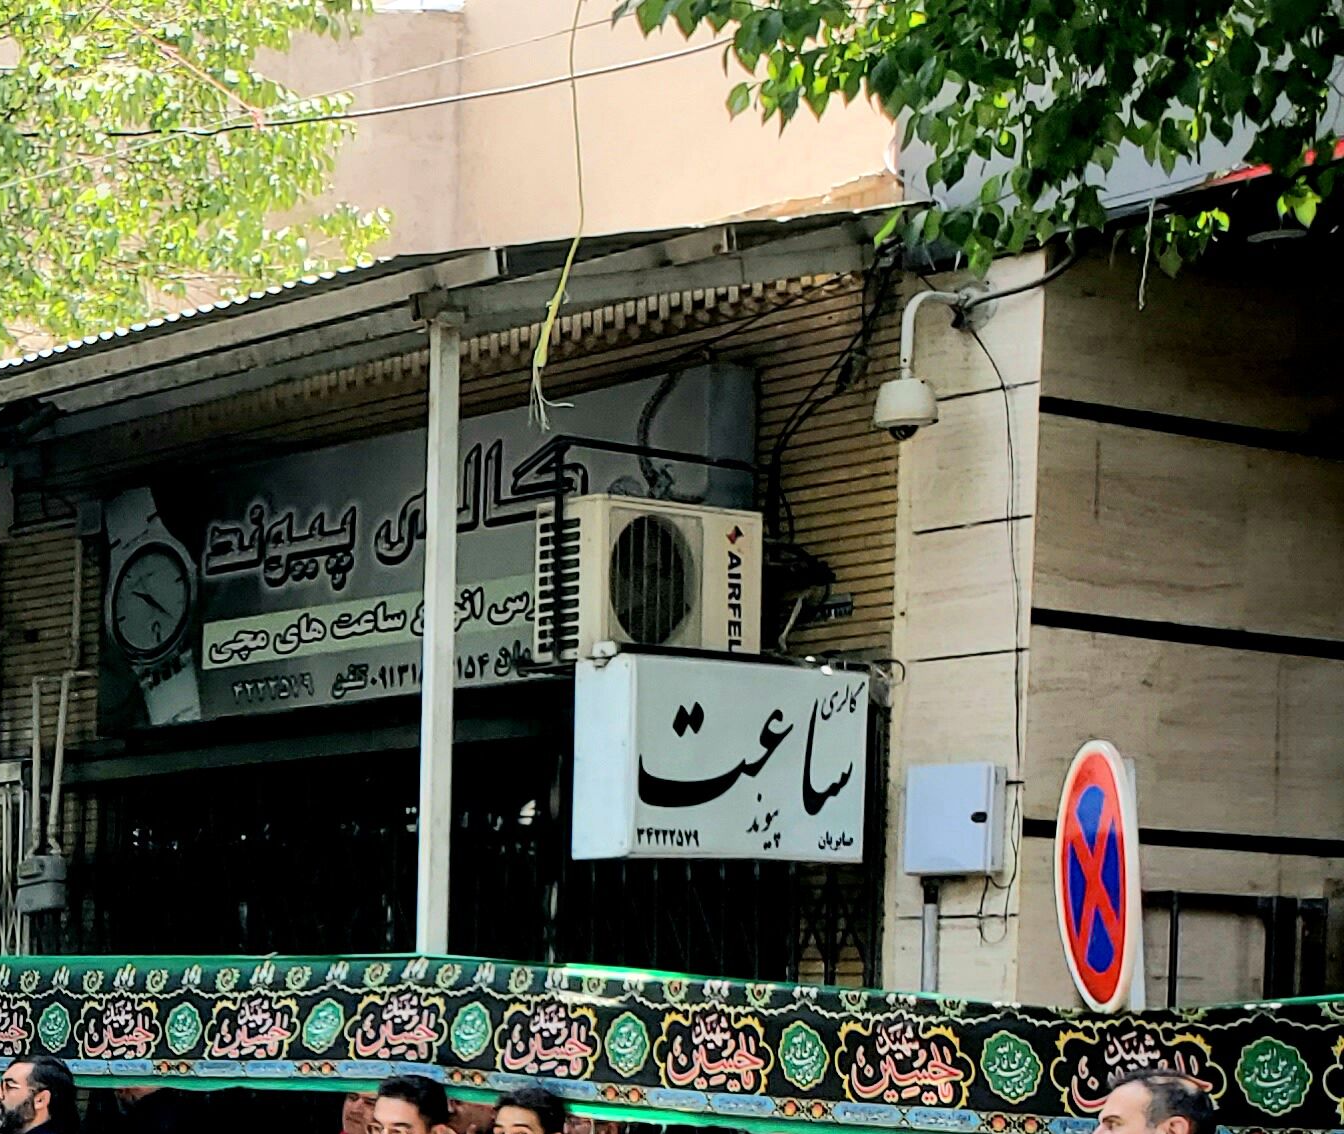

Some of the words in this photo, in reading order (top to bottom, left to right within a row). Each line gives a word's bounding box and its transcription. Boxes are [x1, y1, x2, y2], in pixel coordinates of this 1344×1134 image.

[330, 600, 408, 640] ساعت
[727, 550, 742, 653] AIRFEL
[209, 630, 270, 664] مچی
[273, 612, 327, 655] های
[638, 698, 853, 816] ساعت
